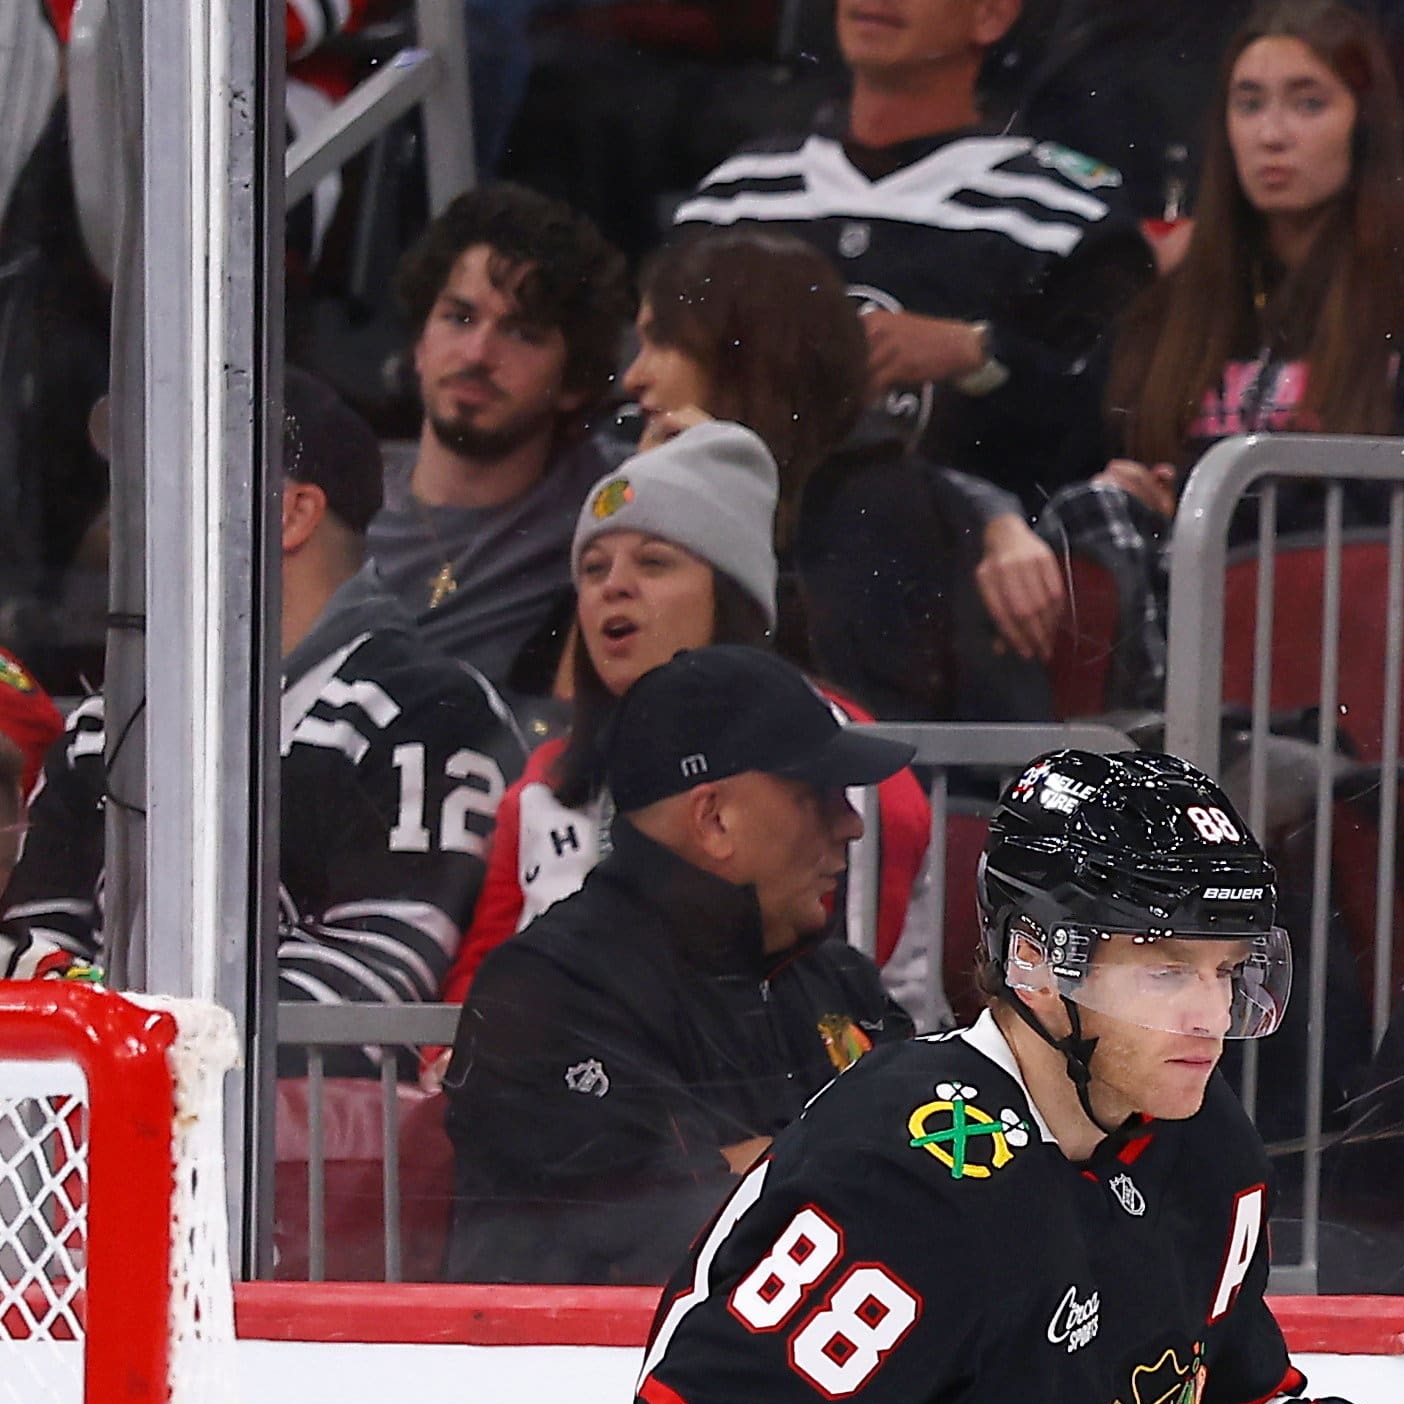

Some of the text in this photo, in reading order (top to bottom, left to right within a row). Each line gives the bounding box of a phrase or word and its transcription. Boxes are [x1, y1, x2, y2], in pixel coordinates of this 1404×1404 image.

[388, 741, 507, 857] 12
[1185, 803, 1242, 844] 88
[1202, 886, 1265, 901] BAUER
[725, 1202, 925, 1401] 88
[1206, 1182, 1267, 1326] A
